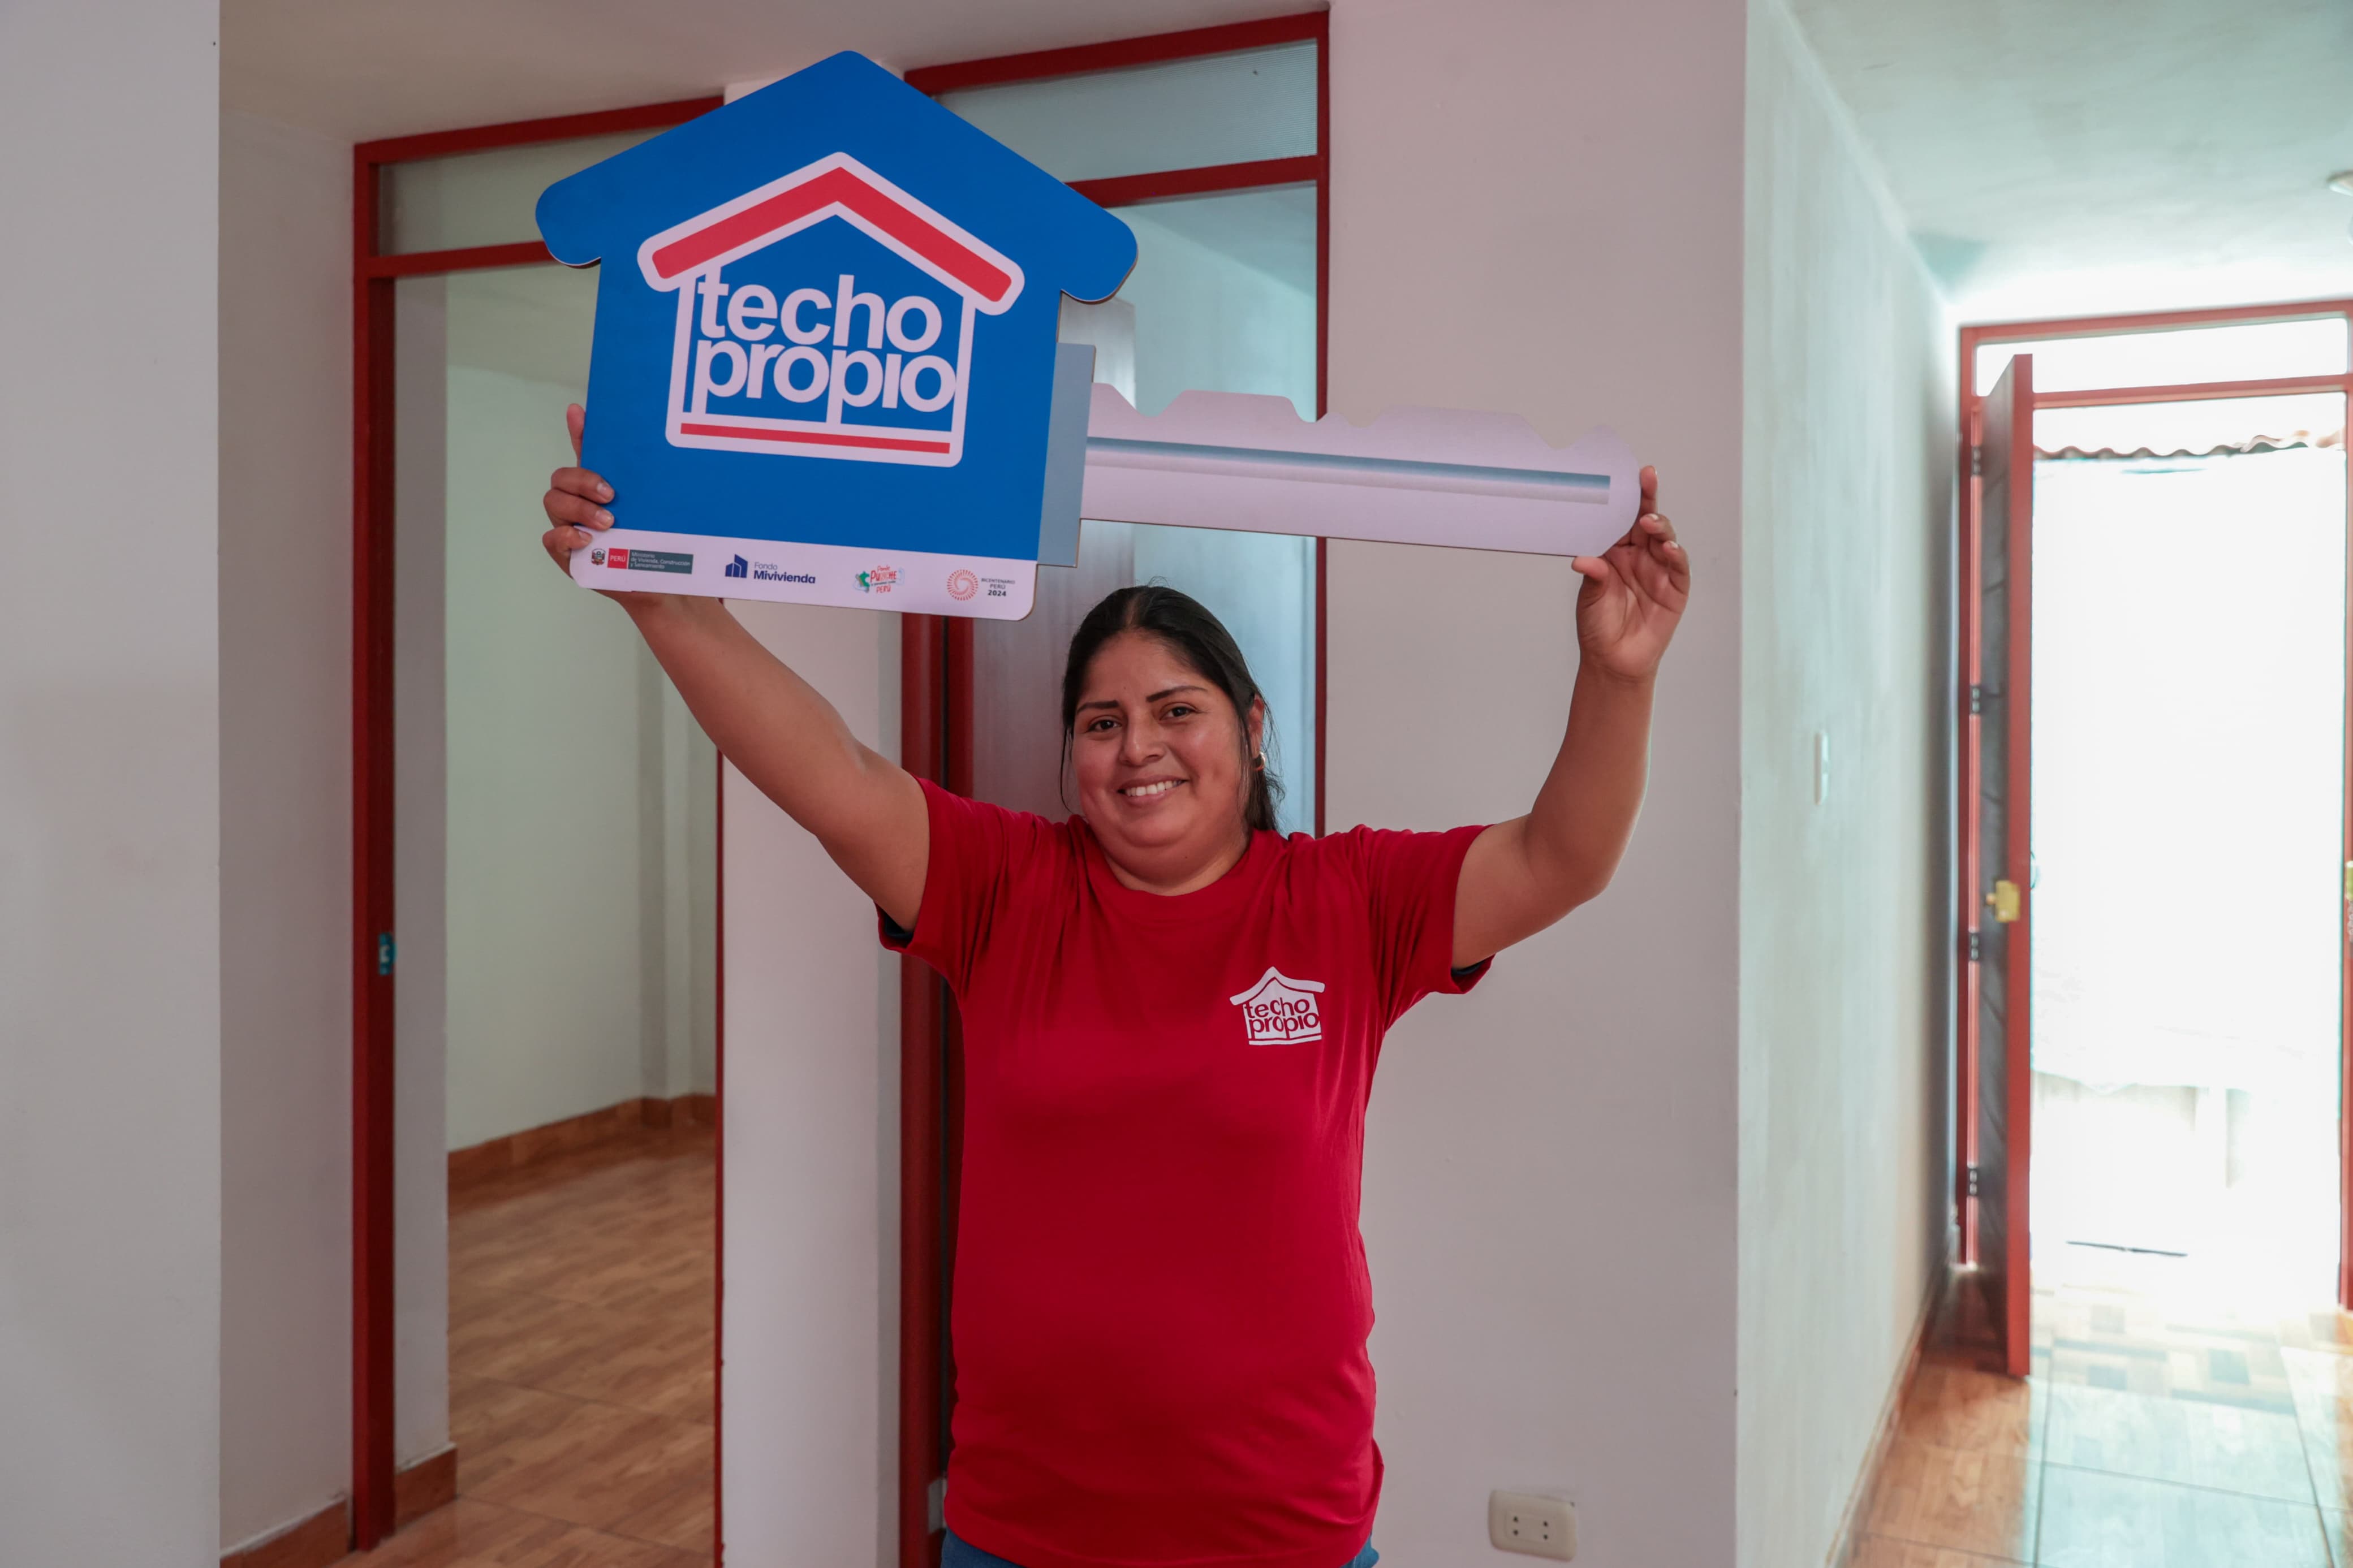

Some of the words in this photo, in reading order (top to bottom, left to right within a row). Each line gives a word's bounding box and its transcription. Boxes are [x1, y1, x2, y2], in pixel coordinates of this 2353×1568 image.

[697, 269, 942, 352] techo
[691, 339, 957, 424] propio
[753, 569, 816, 584] Mivivienda
[754, 561, 778, 570] Fondo
[1244, 997, 1310, 1018] techo
[1248, 1012, 1320, 1039] propio
